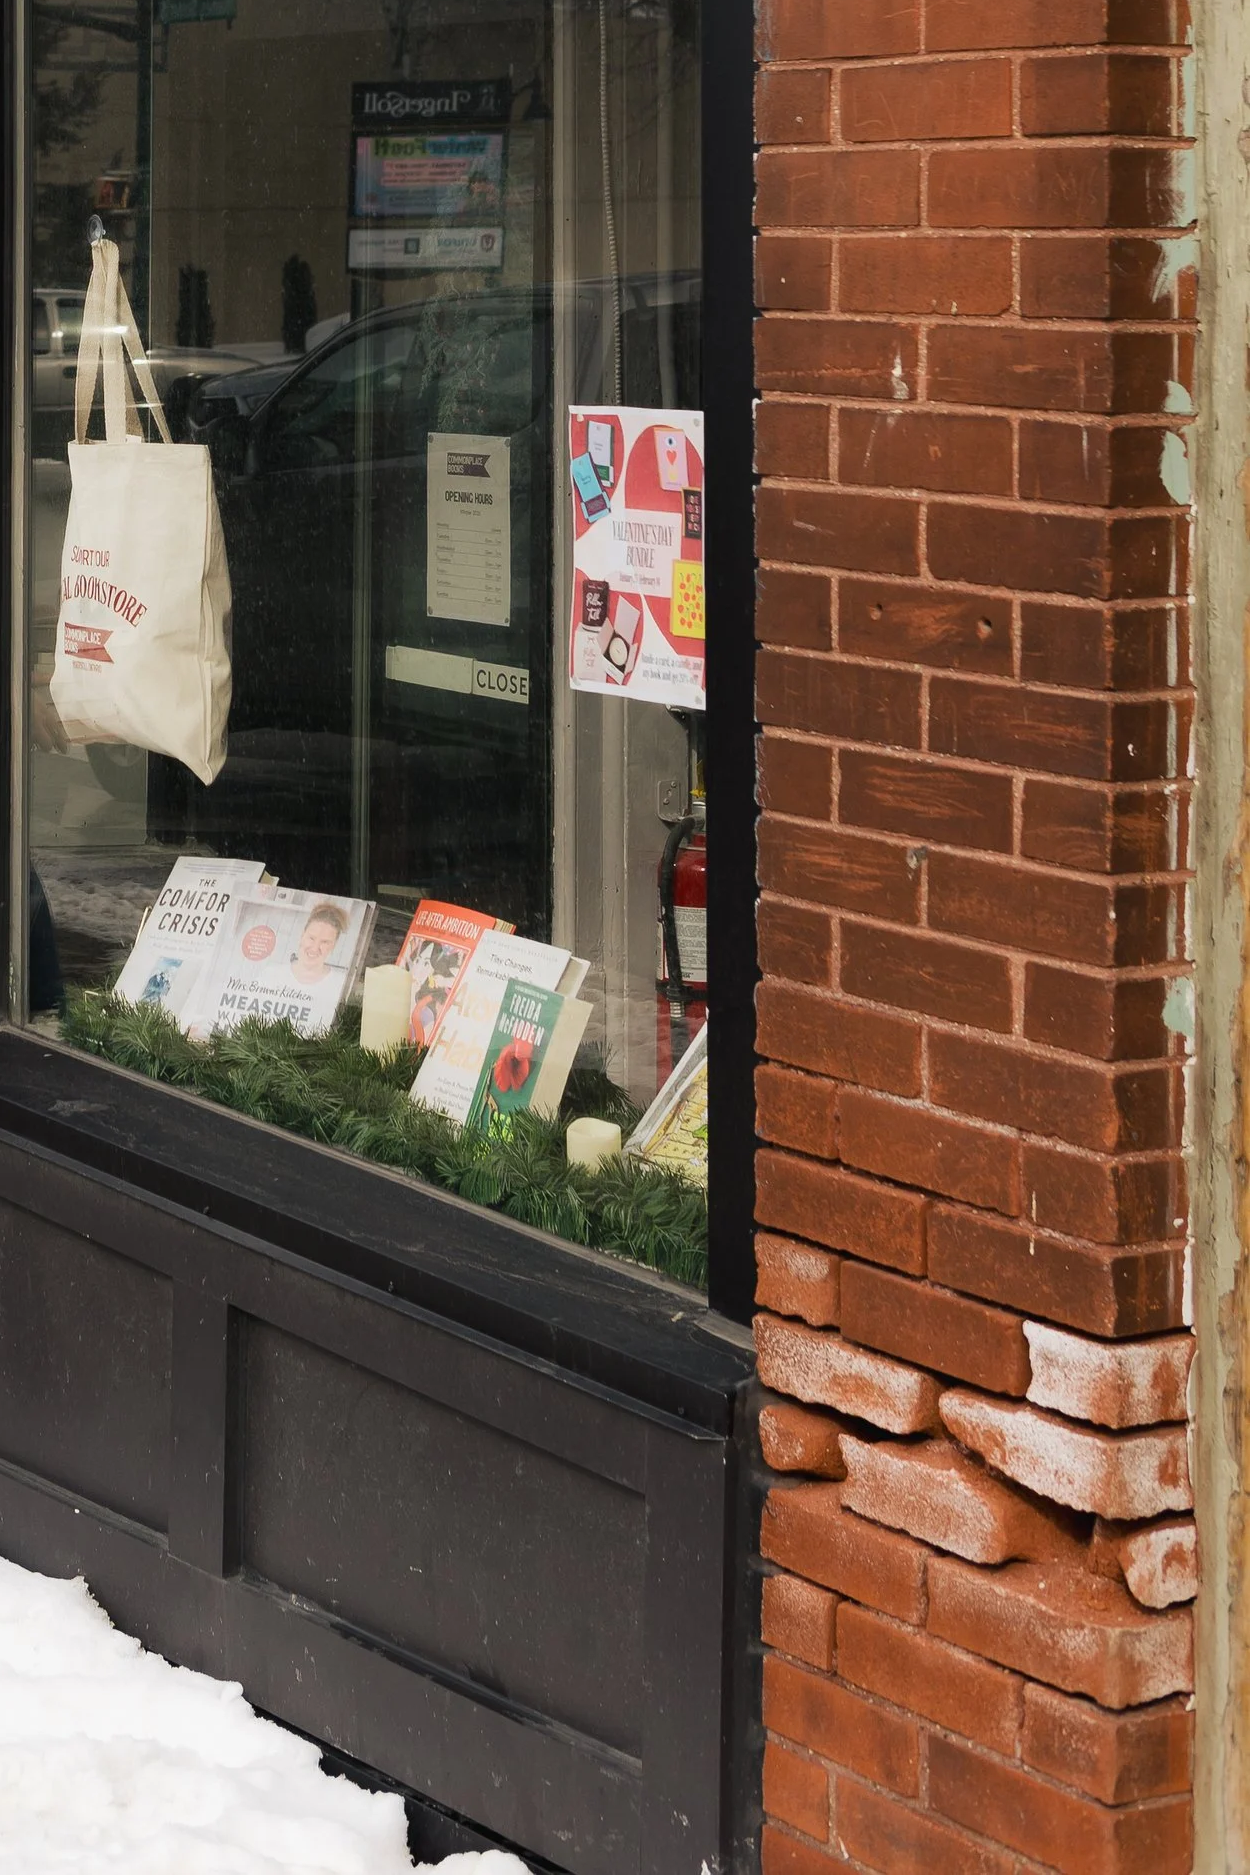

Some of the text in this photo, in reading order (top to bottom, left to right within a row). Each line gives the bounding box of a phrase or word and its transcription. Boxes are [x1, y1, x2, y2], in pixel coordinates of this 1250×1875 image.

[447, 455, 484, 466] COMMONPLACE
[447, 465, 465, 473] BOOKS
[445, 490, 494, 506] OPENING HOURS
[612, 520, 676, 546] VALENTINE'S DAY
[95, 550, 110, 567] OUR
[626, 546, 655, 569] BUNDLE
[74, 574, 148, 628] BOOKSTORE
[199, 878, 217, 888] THE
[159, 888, 231, 913] COMFOR
[158, 912, 219, 937] CRISIS
[416, 910, 427, 926] LIFE
[425, 912, 443, 930] AFTER
[441, 916, 481, 940] AMBITION
[490, 954, 504, 966] Tiny
[219, 992, 311, 1022] MEASURE
[510, 993, 542, 1023] FREIDA
[498, 1012, 545, 1047] McFADDEN
